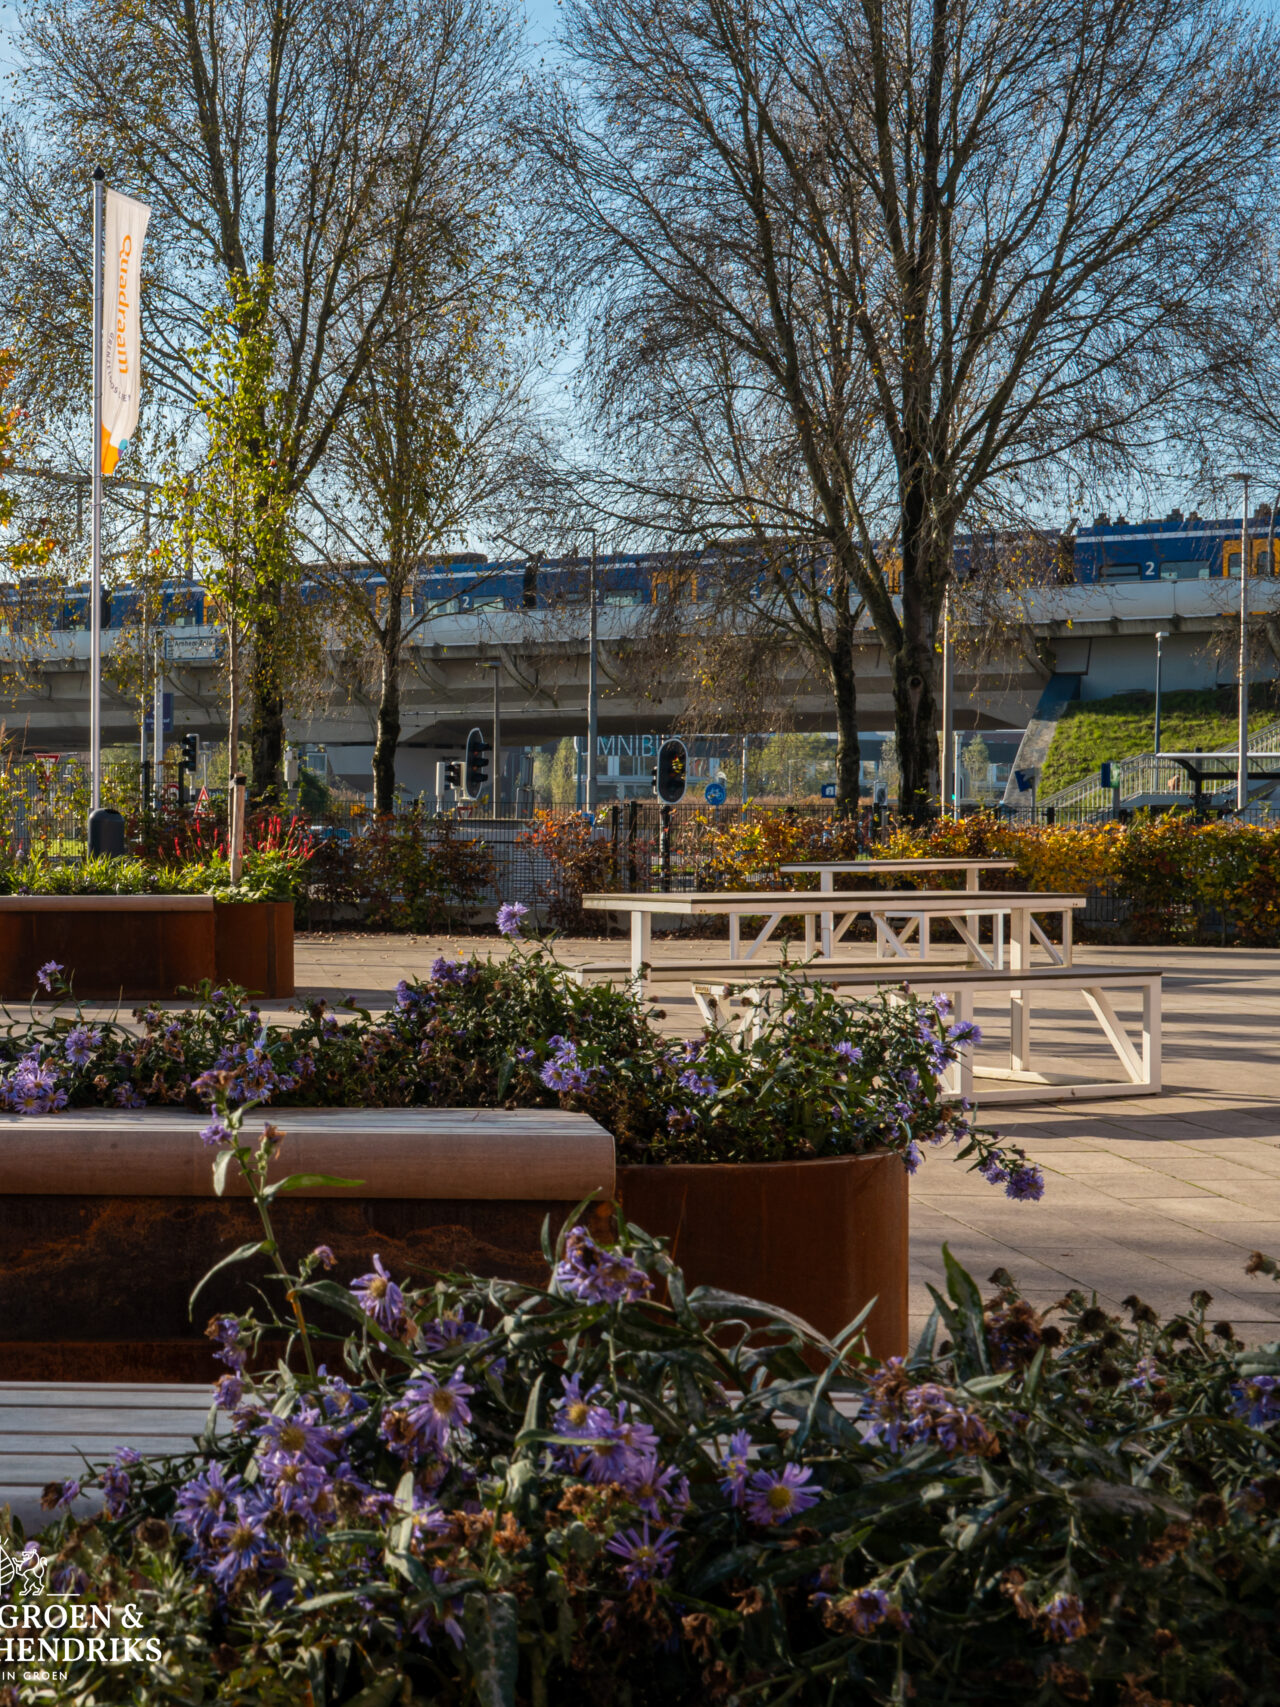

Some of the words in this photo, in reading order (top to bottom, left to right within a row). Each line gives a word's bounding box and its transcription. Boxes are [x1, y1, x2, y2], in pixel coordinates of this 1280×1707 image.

[116, 234, 132, 374] Quadraam
[1145, 561, 1155, 576] 2
[462, 596, 470, 608] 2
